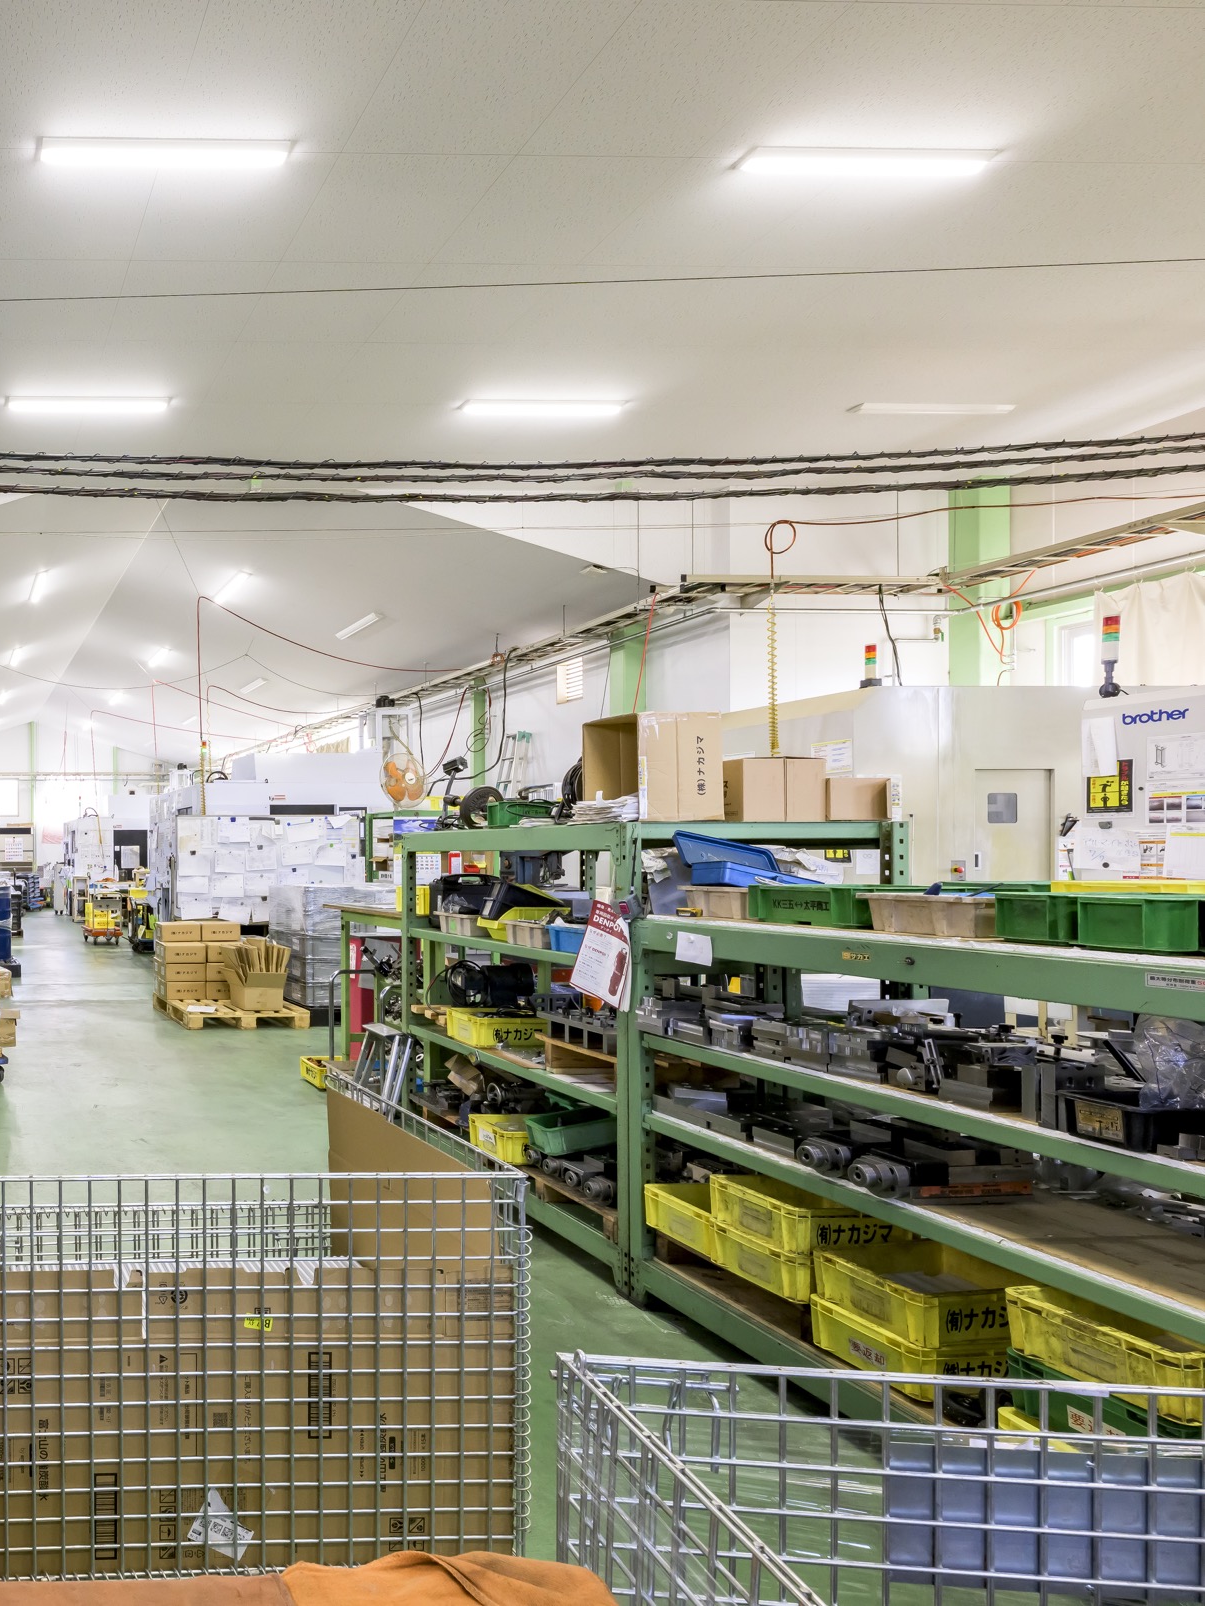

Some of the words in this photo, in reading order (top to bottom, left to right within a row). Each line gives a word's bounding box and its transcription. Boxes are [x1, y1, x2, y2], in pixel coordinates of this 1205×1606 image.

[1121, 708, 1190, 726] brother
[695, 735, 707, 796] (株)ナカジマ
[816, 1223, 893, 1246] (有)ナカジマ
